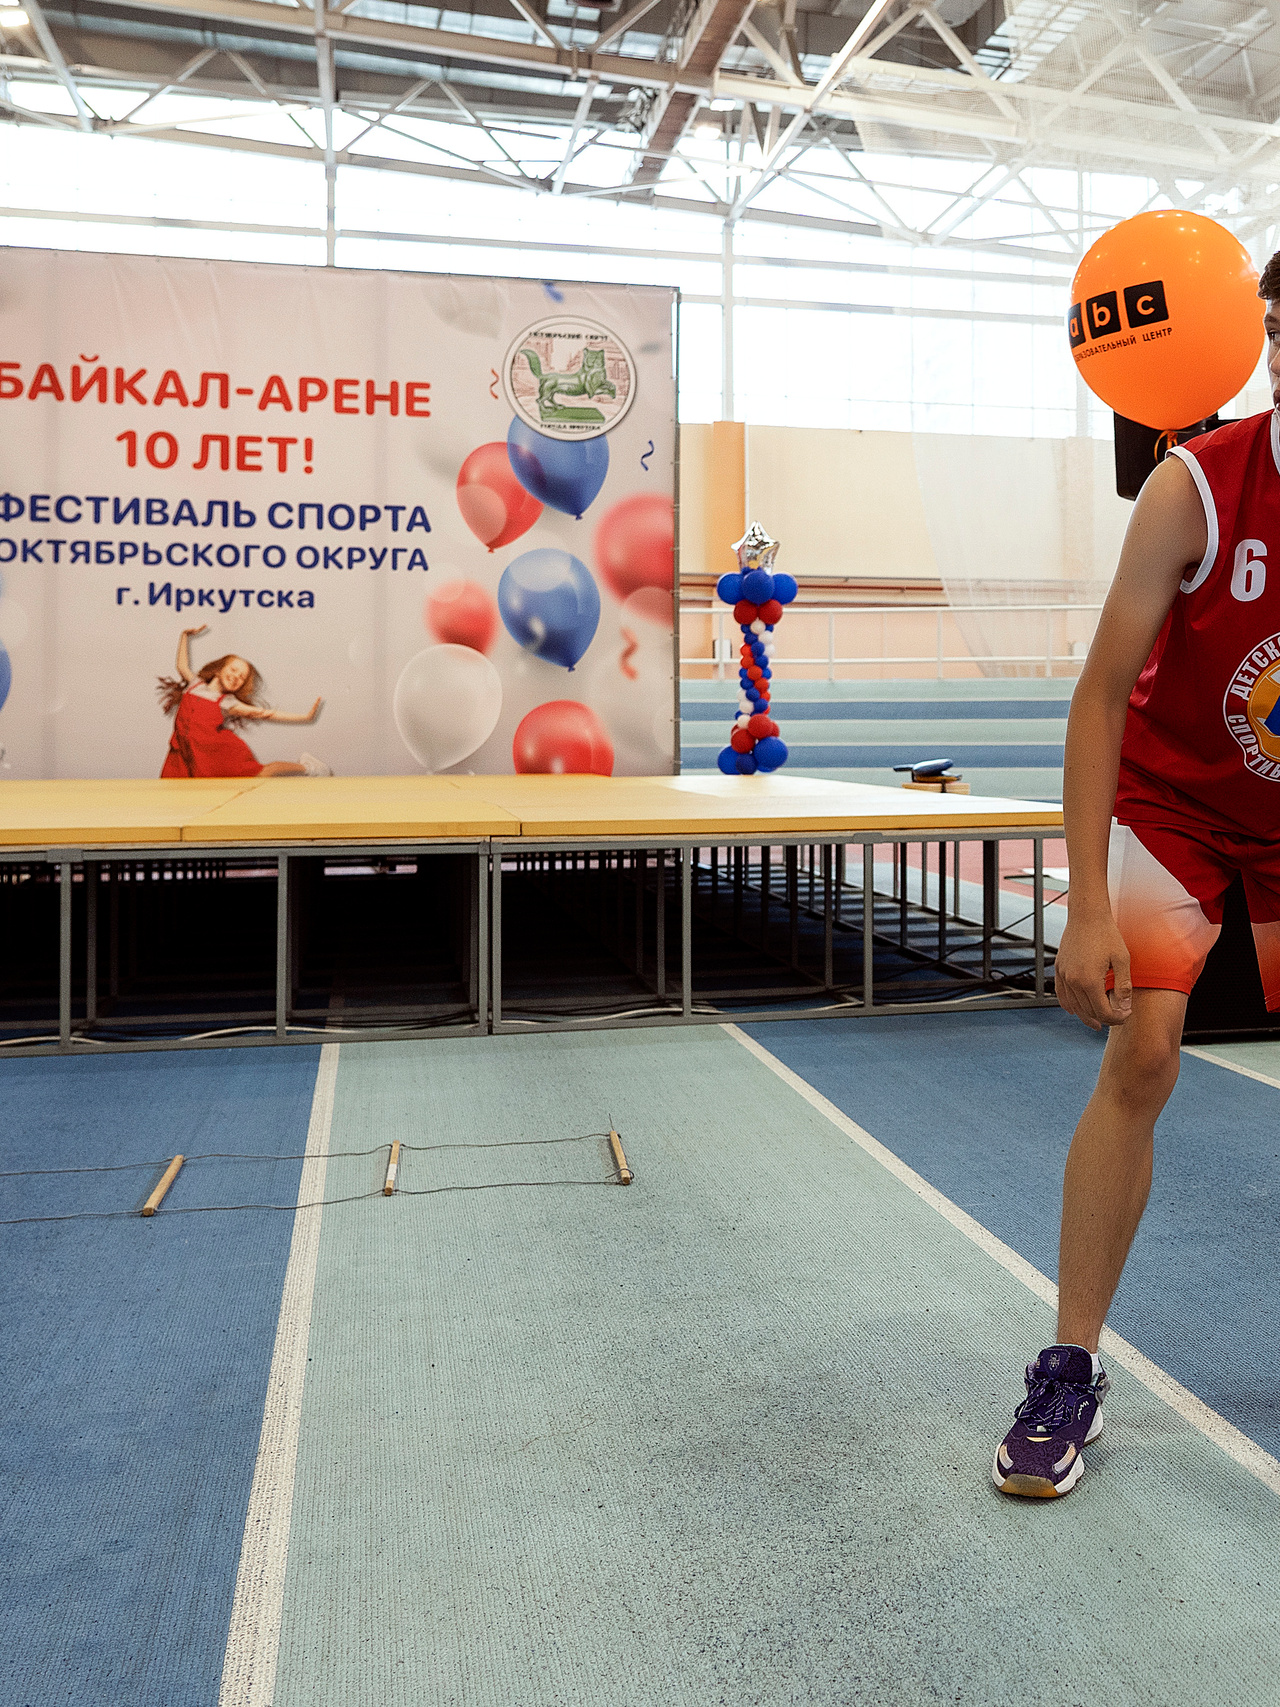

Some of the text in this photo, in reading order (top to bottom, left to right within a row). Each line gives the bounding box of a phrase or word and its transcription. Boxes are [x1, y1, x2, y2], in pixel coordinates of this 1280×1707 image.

[1142, 327, 1173, 342] ЦЕНТР
[0, 353, 432, 418] БАЙКАЛ-АРЕНЕ
[115, 430, 314, 475] 10 ЛЕТ!
[0, 492, 432, 533] ФЕСТИВАЛЬ СПОРТА
[0, 537, 429, 572] ОКТЯБРЬСКОГО ОКРУГА
[1230, 538, 1268, 602] 6
[116, 582, 315, 613] г. Иркутска
